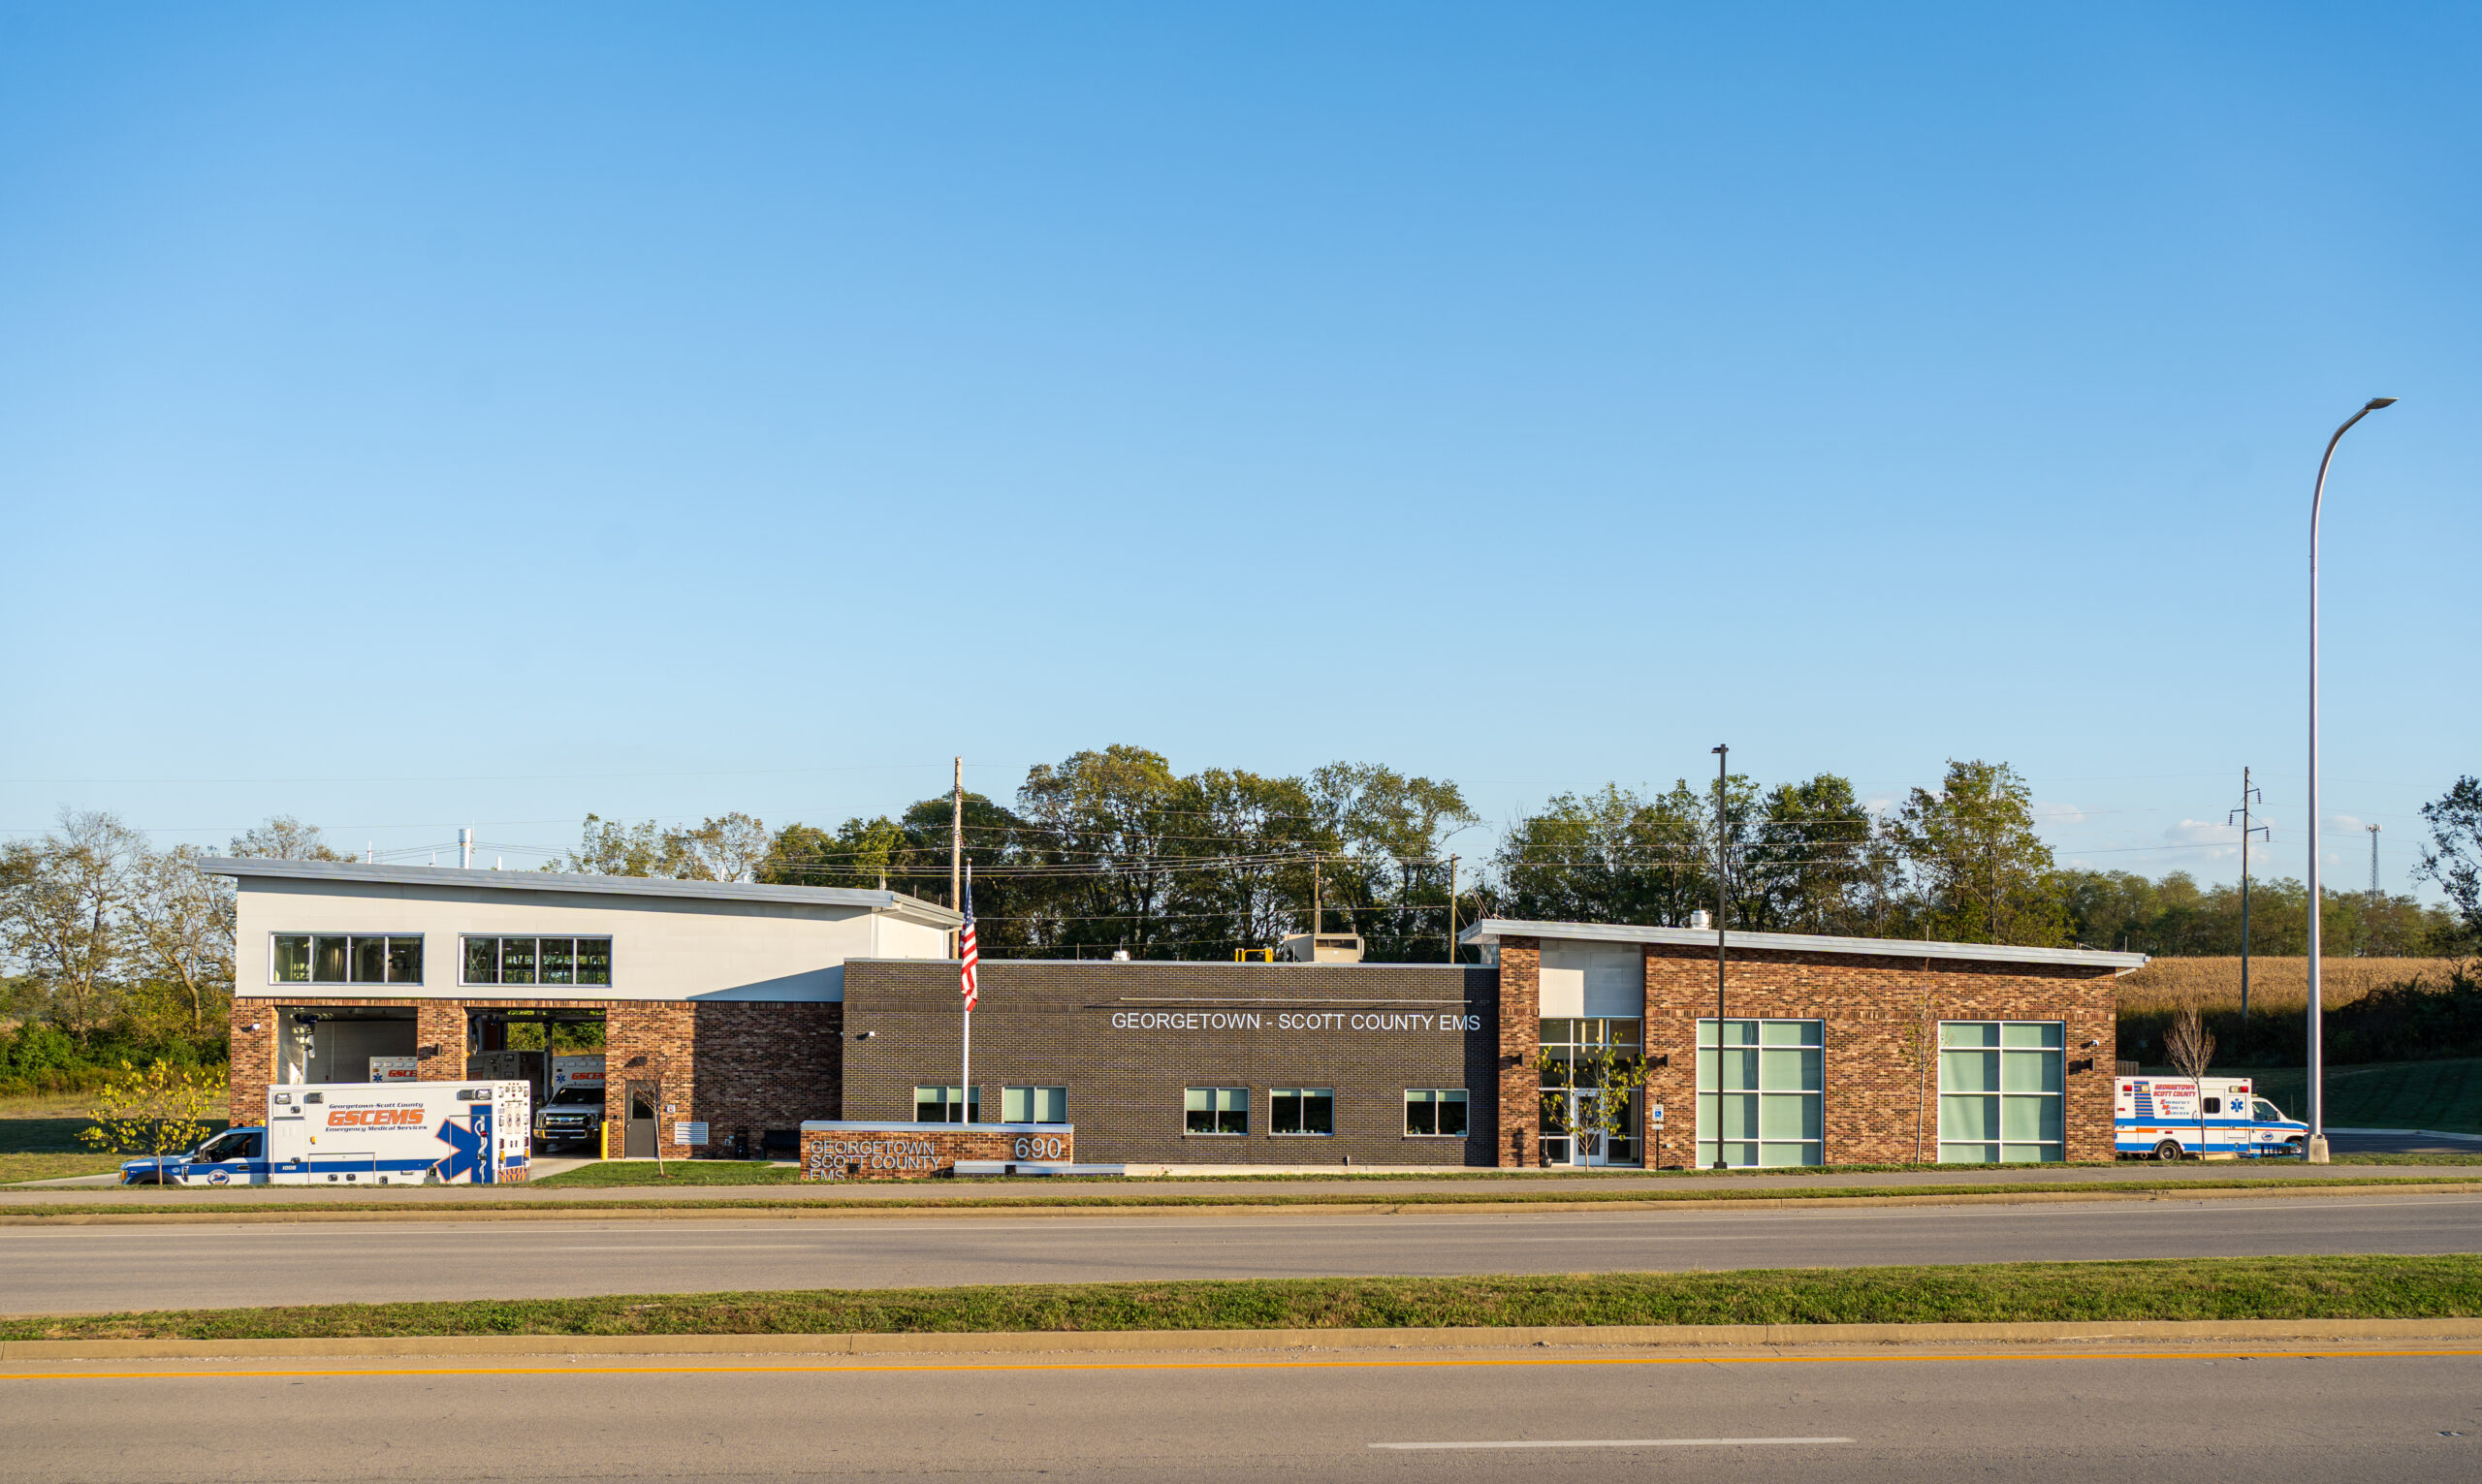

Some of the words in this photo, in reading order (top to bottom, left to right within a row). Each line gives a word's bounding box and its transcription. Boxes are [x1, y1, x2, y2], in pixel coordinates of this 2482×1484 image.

[1111, 1012, 1260, 1029] GEORGETOWN
[1278, 1013, 1346, 1029] SCOTT
[1351, 1014, 1434, 1030] COUNTY
[1439, 1014, 1480, 1030] EMS
[388, 1069, 417, 1078] GSCE
[328, 1109, 426, 1126] GSCEMS
[810, 1140, 935, 1155] GEORGETOWN
[1014, 1137, 1062, 1158] 690
[810, 1154, 867, 1169] SCOTT
[871, 1155, 942, 1170] COUNTY
[810, 1169, 845, 1181] EMS
